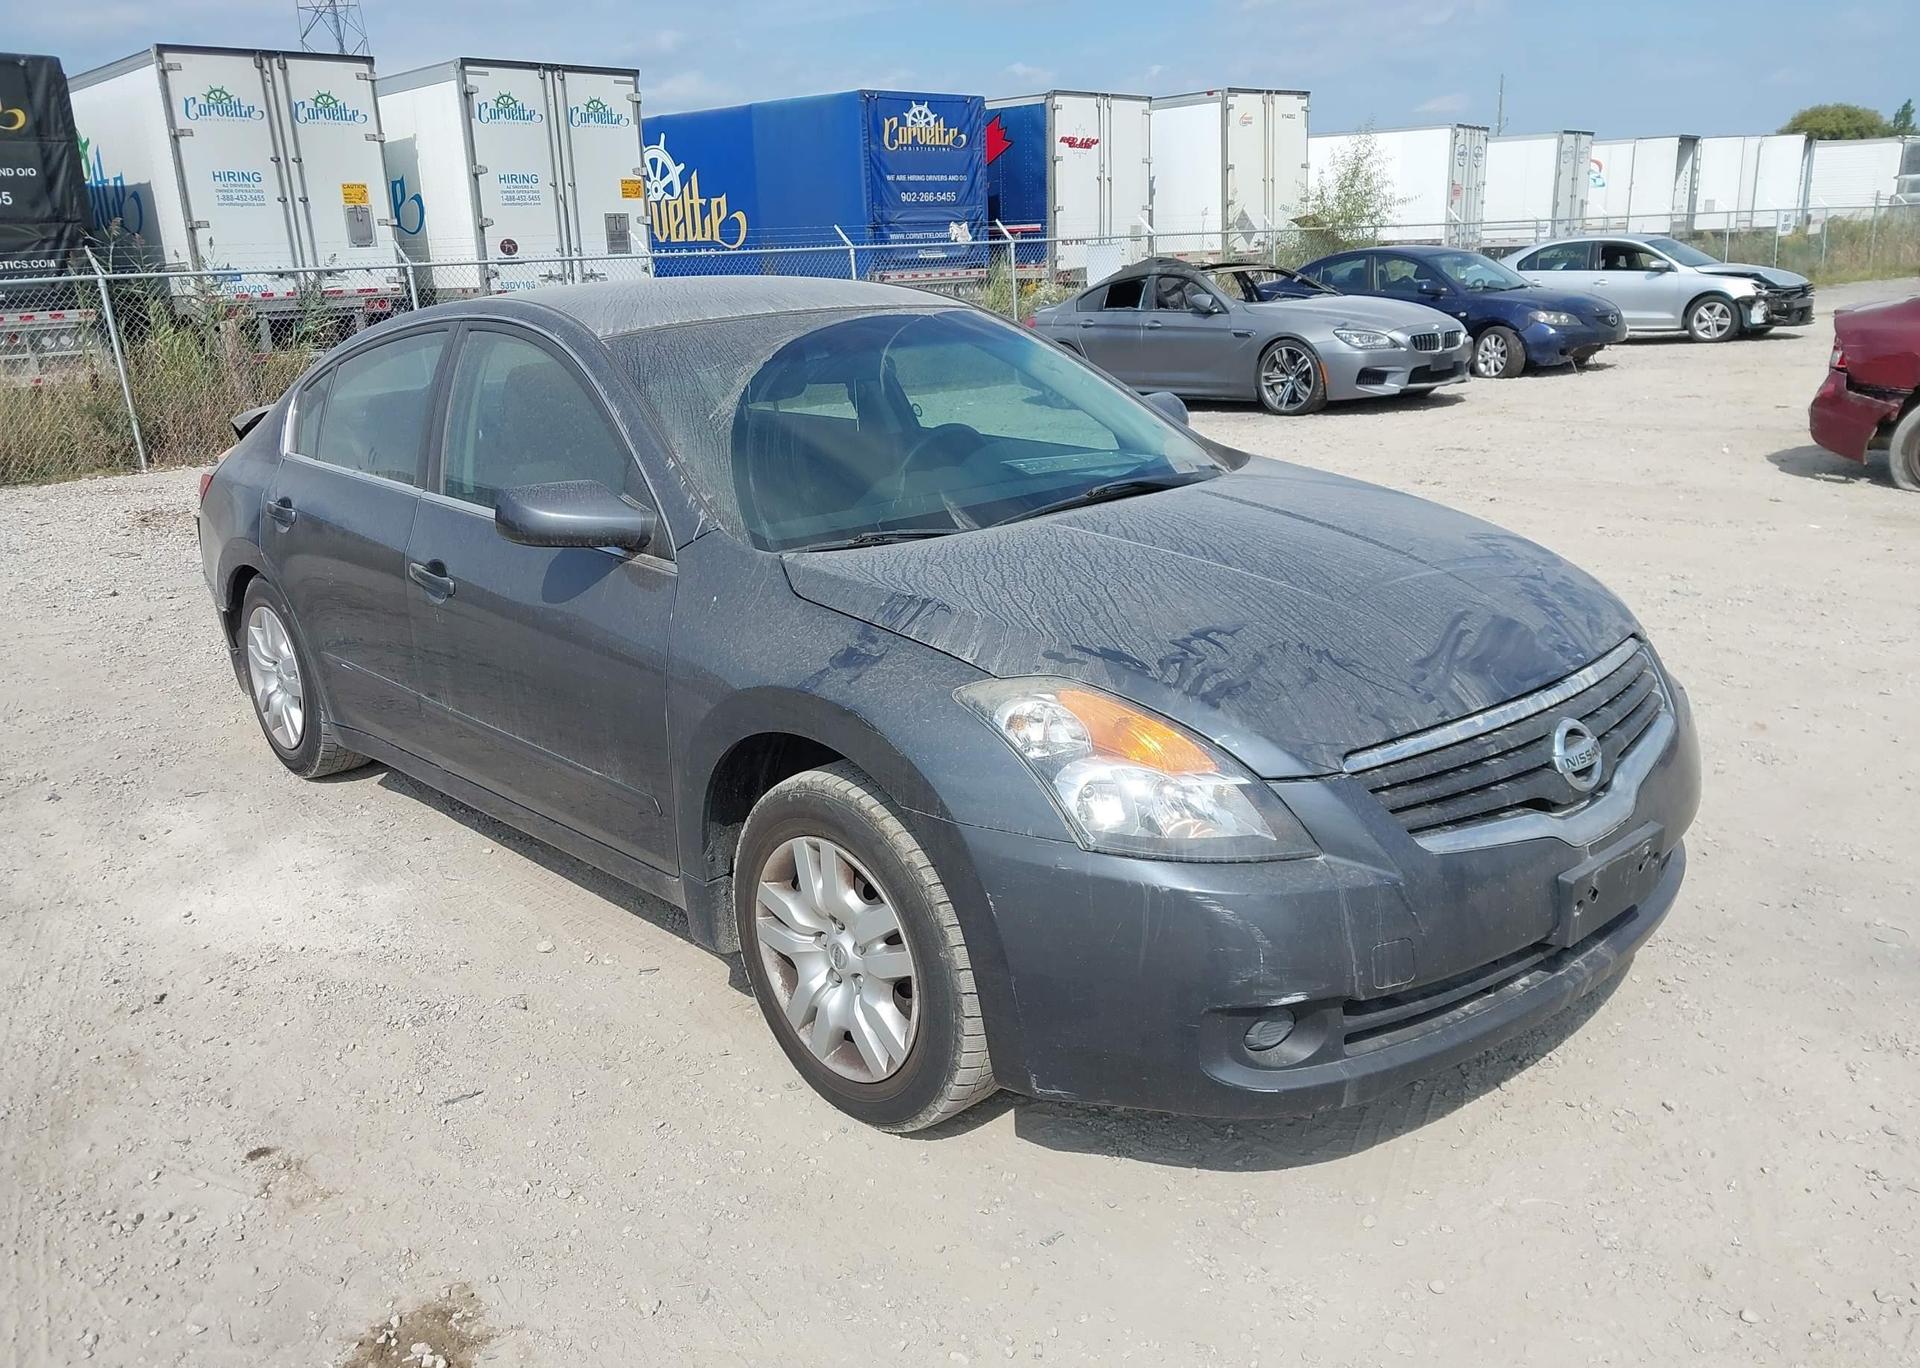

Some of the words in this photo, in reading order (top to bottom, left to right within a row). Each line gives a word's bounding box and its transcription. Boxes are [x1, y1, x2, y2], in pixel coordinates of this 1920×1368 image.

[184, 96, 265, 121] Corvette
[294, 100, 368, 124] Corvette
[478, 102, 544, 124] Corvette
[570, 106, 630, 128] Corvette
[884, 116, 967, 150] Corvette
[212, 170, 262, 183] HIRING
[498, 173, 539, 184] HIRING
[216, 194, 266, 202] 1-888-452-5455
[900, 191, 957, 202] 902-266-5455
[1565, 746, 1598, 769] NISSA
